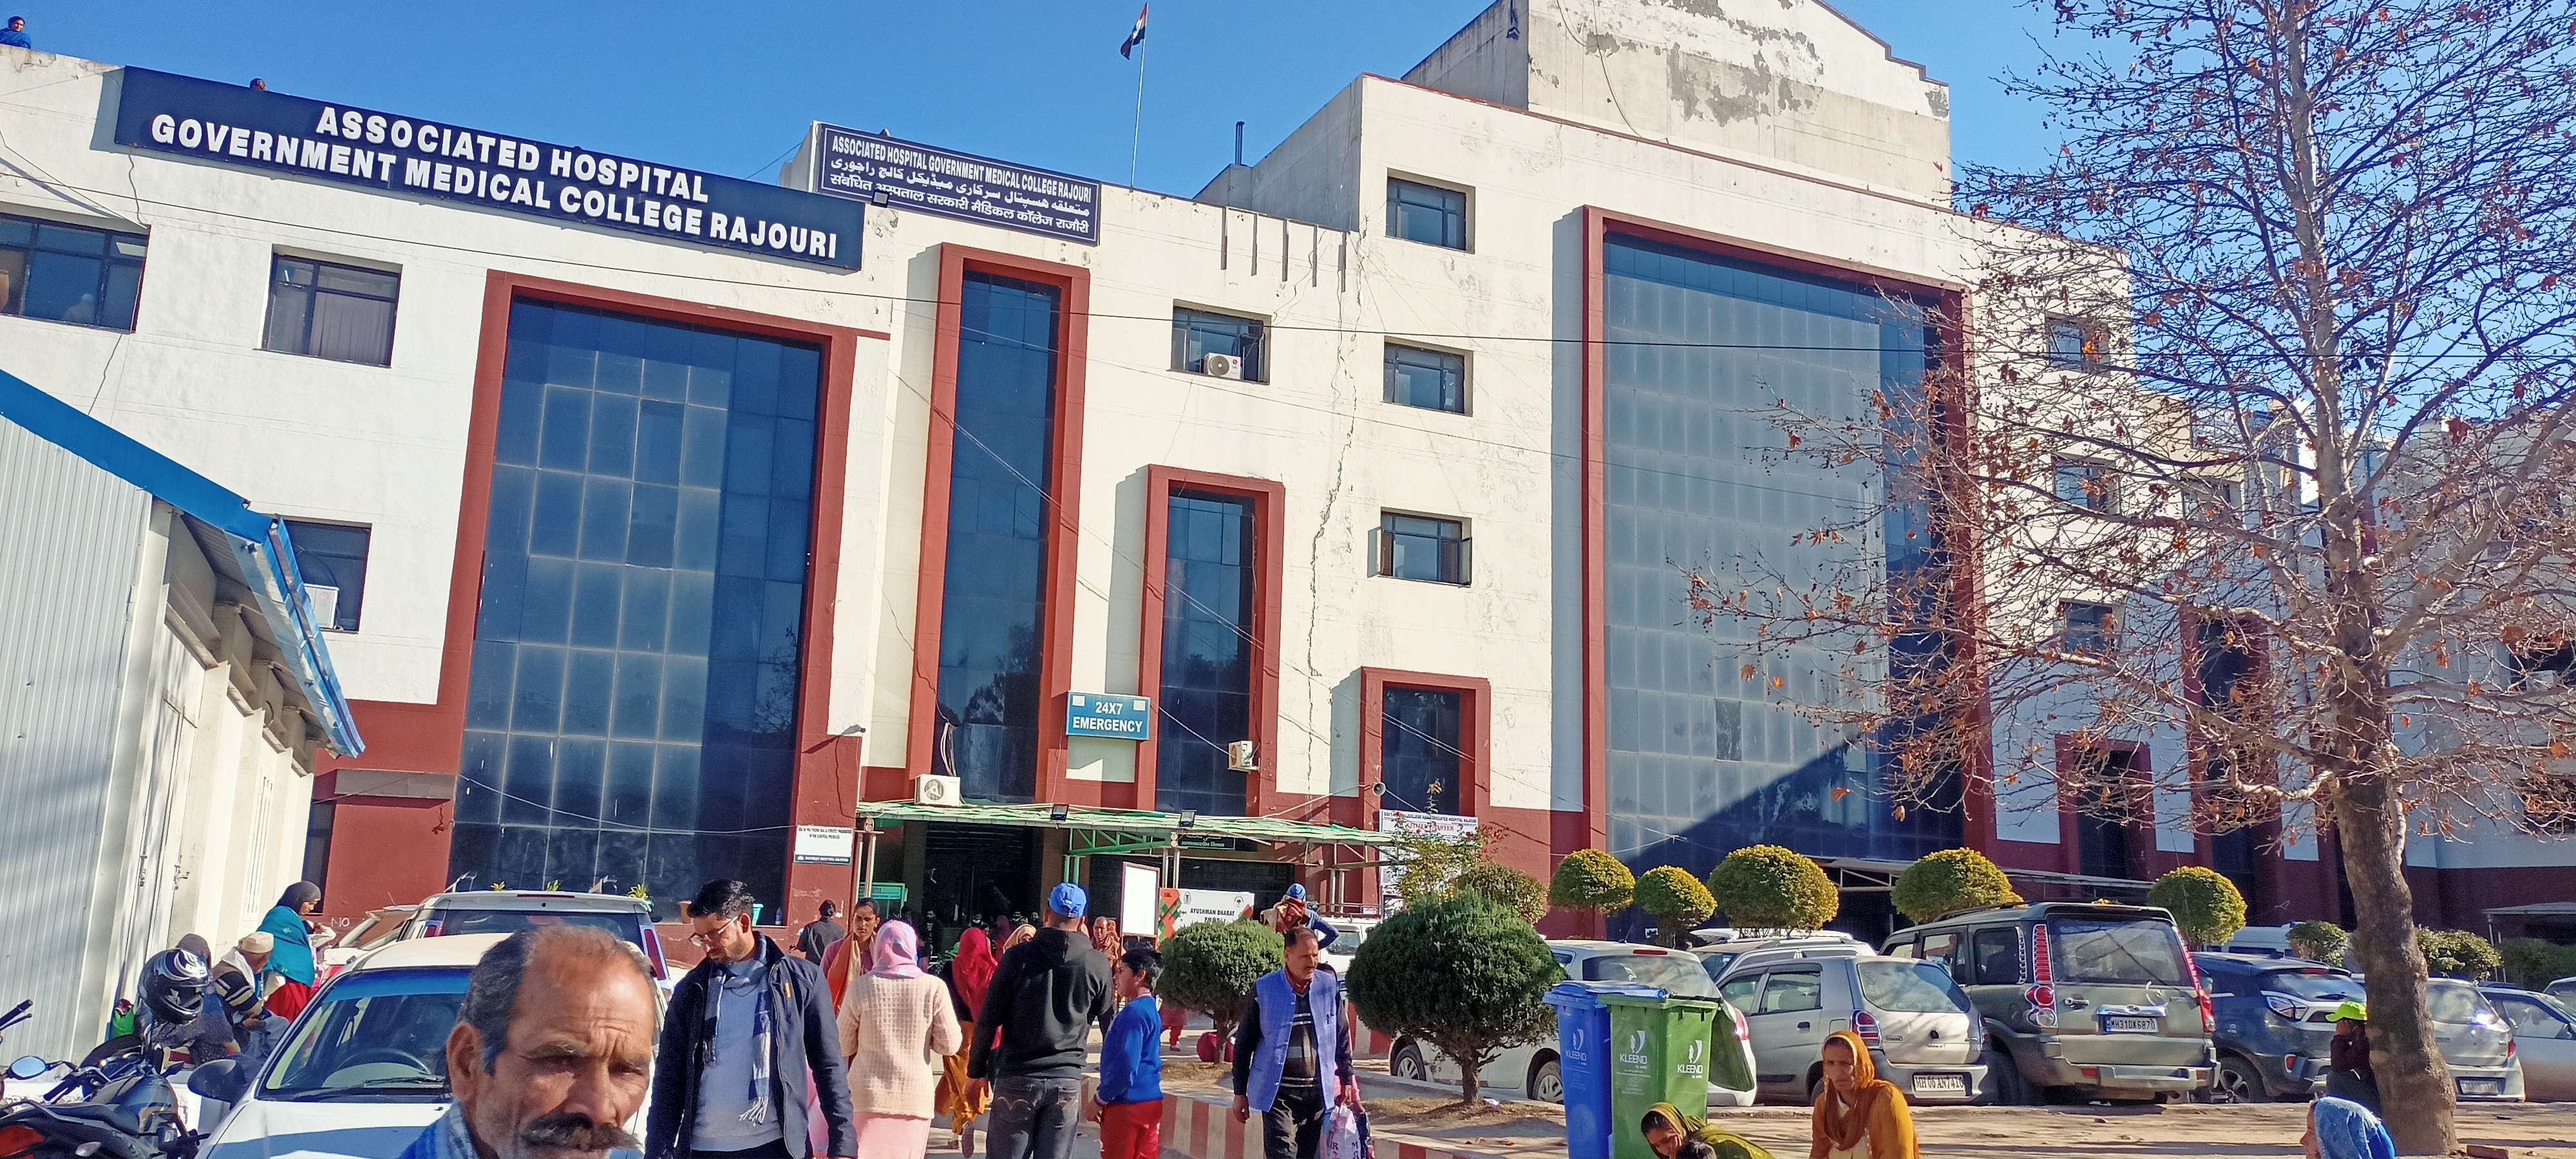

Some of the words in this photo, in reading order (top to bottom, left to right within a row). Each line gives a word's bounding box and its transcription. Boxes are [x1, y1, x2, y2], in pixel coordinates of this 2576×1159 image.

[316, 106, 540, 171] ASSOCIATED
[550, 148, 709, 203] HOSPITAL
[832, 135, 886, 161] ASSOCIATED
[887, 146, 927, 170] HOSPITAL
[929, 155, 984, 182] GOVERNMENT
[985, 167, 1020, 189] MEDICAL
[1021, 174, 1057, 196] COLLEGE
[1058, 182, 1092, 203] RAJOURI
[152, 114, 397, 182] GOVERNMENT
[404, 158, 551, 209] MEDICAL
[560, 185, 703, 236] COLLEGE
[710, 212, 837, 259] RAJOURI
[927, 193, 969, 210] सरकारी
[1016, 209, 1054, 226] कॉलेज
[1095, 701, 1123, 715] 24X7
[1072, 716, 1143, 733] EMERGENCY
[2110, 1020, 2155, 1030] MH31DK6870
[1915, 1077, 1927, 1088] MH
[1927, 1076, 1936, 1088] 06
